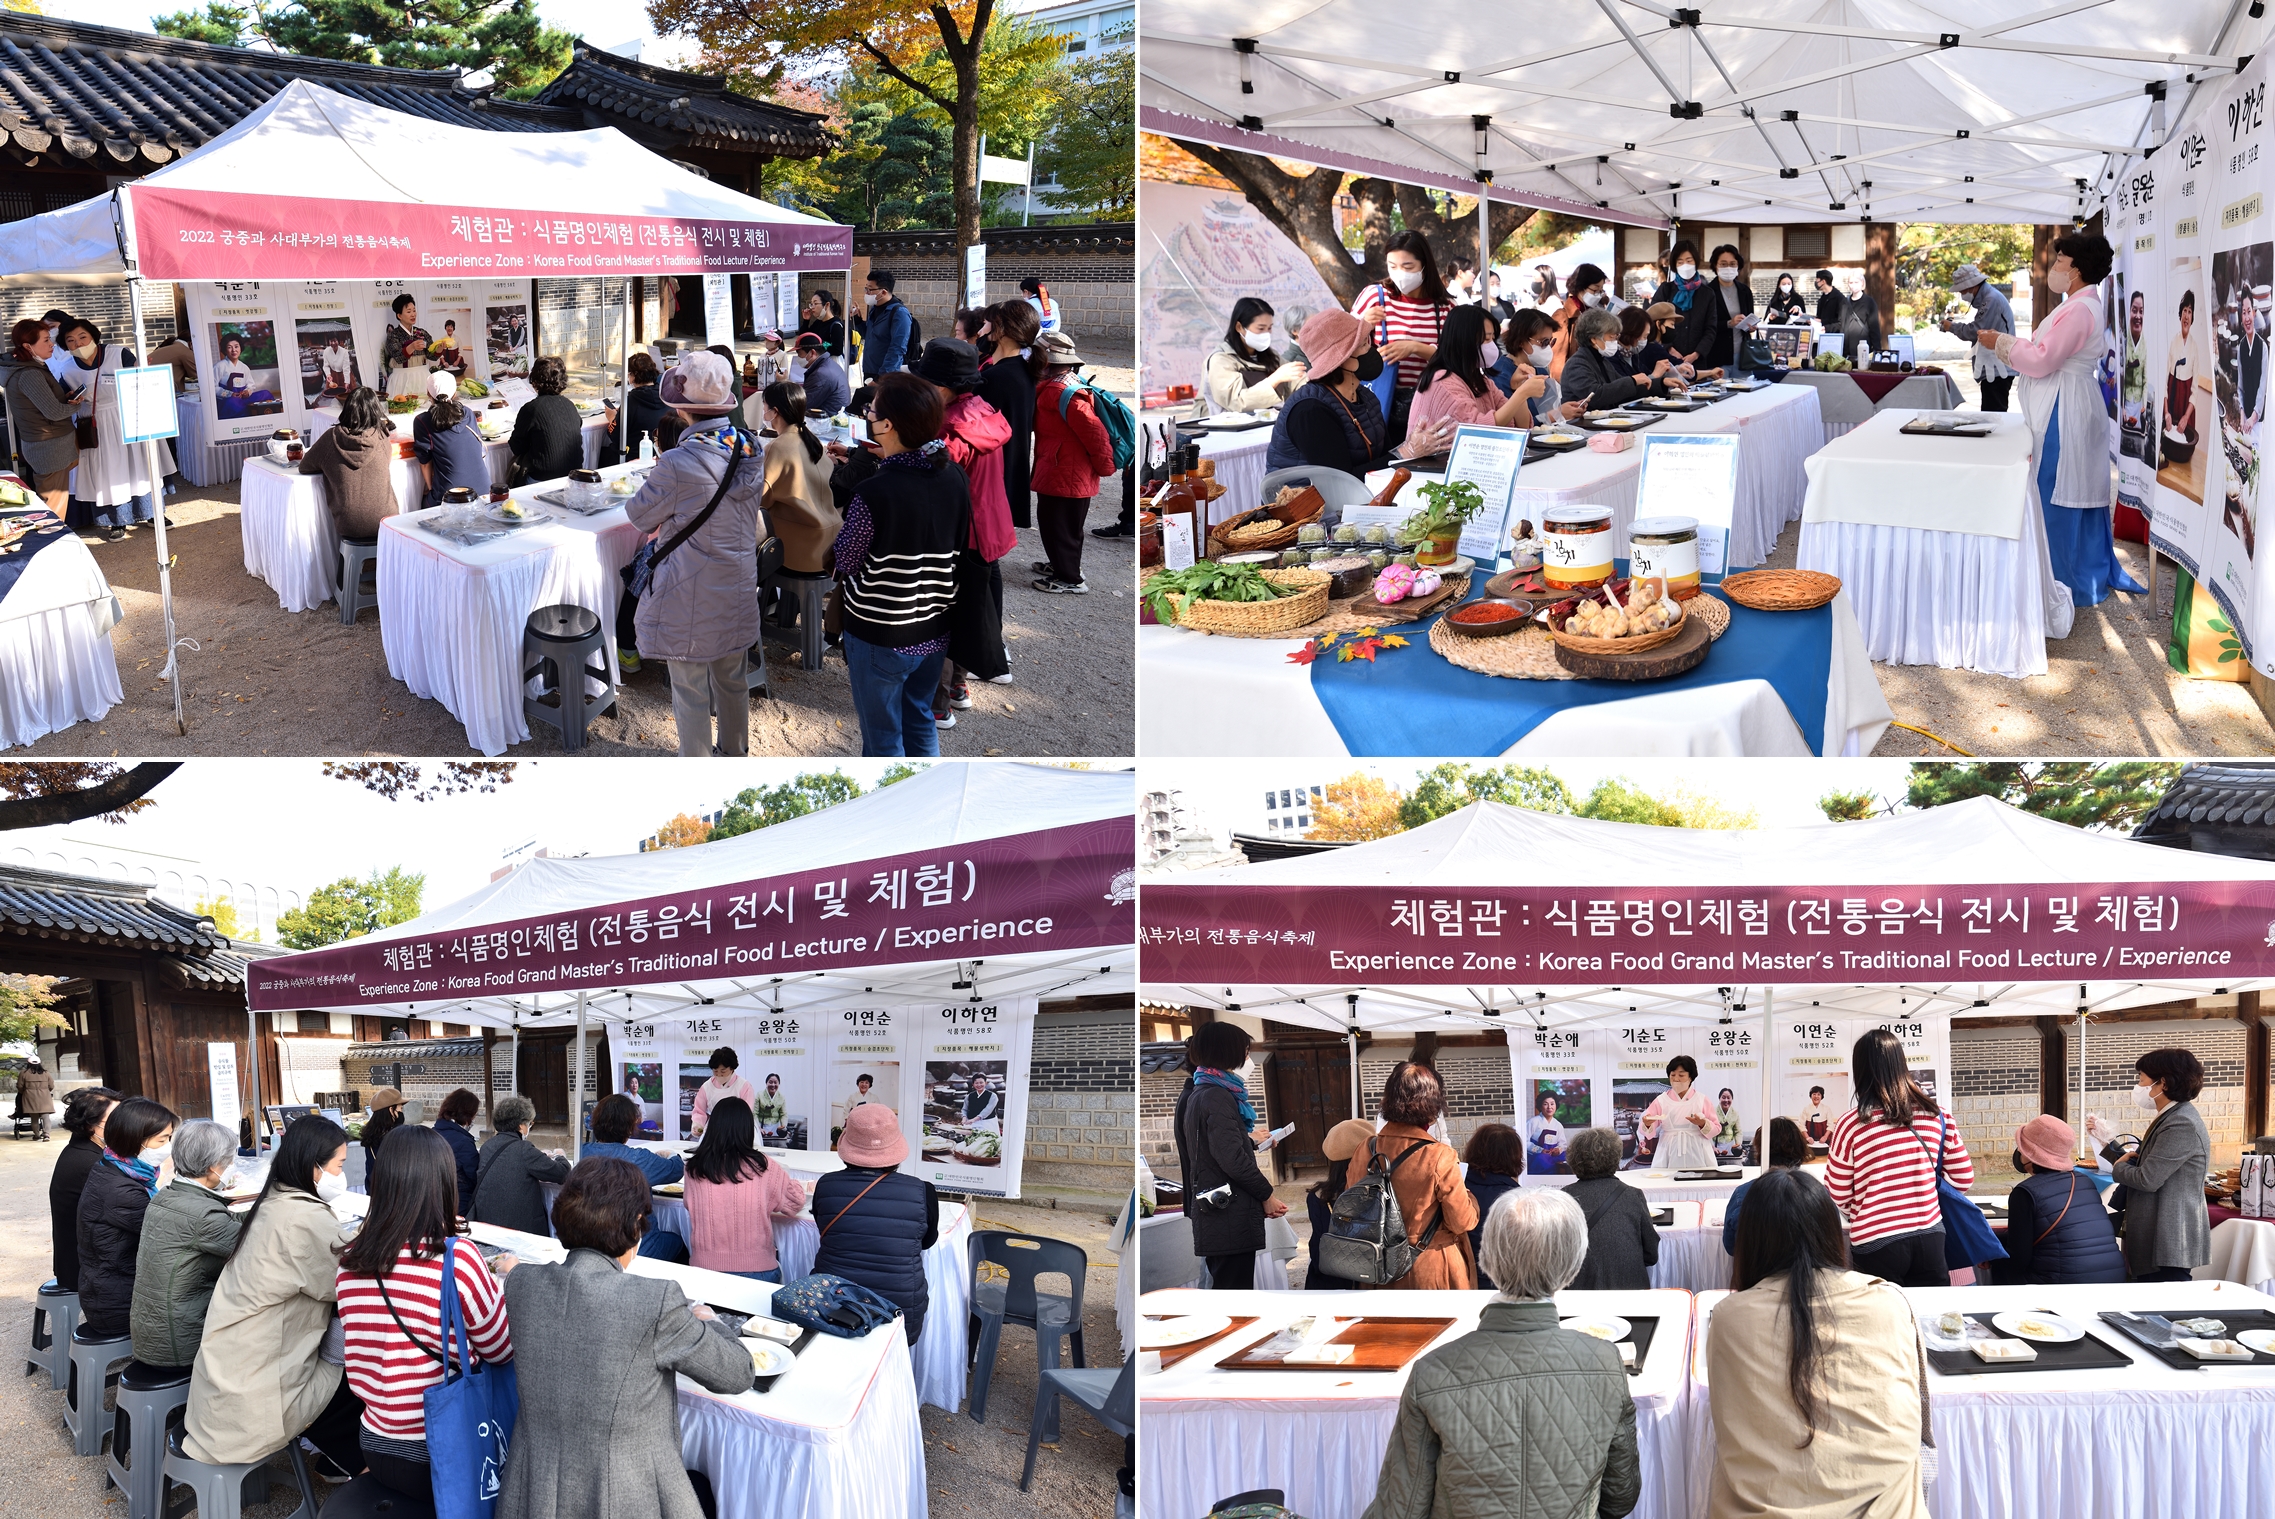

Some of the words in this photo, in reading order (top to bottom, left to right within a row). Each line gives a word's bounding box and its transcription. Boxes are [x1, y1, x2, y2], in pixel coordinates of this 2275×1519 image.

[179, 230, 214, 243] 2022
[219, 230, 265, 247] 궁중과
[270, 231, 337, 248] 사대부가의
[342, 234, 411, 250] 전통음식축제
[451, 215, 514, 243] 체험관
[533, 219, 633, 246] 식품명인체험
[639, 224, 697, 247] (전통음식
[701, 227, 725, 248] 전시
[729, 228, 740, 246] 및
[744, 228, 770, 248] 체험)
[421, 253, 492, 269] Experience
[496, 254, 523, 266] Zone
[534, 254, 565, 266] Korea
[568, 254, 592, 266] Food
[594, 254, 622, 266] Grand
[624, 254, 660, 266] Master's
[662, 255, 702, 266] Traditional
[703, 255, 722, 266] Food
[723, 255, 748, 266] Lecture
[754, 255, 786, 267] Experience
[1554, 540, 1575, 565] 김치
[1634, 550, 1651, 575] 김치
[383, 944, 433, 972] 체험관
[450, 919, 578, 965] 식품명인체험
[589, 899, 713, 948] (전통음식
[726, 885, 795, 932] 전시
[814, 876, 850, 922] 및
[867, 859, 977, 912] 체험)
[1390, 899, 1507, 937] 체험관
[1544, 898, 1769, 937] 식품명인체험
[1786, 897, 1943, 936] (전통음식
[1961, 896, 2029, 935] 전시
[2048, 896, 2080, 933] 및
[2094, 895, 2179, 933] 체험)
[1206, 928, 1315, 946] 전통음식축제
[359, 978, 410, 997] Experience
[413, 977, 438, 993] Zone
[448, 973, 480, 990] Korea
[484, 970, 514, 987] Food
[518, 965, 556, 984] Grand
[560, 959, 624, 980] Master's
[628, 949, 718, 975] Traditional
[724, 943, 774, 965] Food
[781, 934, 867, 960] Lecture
[894, 916, 1053, 950] Experience
[1330, 950, 1454, 973] Experience
[1462, 951, 1517, 970] Zone
[1539, 951, 1602, 970] Korea
[1610, 951, 1663, 970] Food
[1671, 951, 1734, 970] Grand
[1742, 950, 1833, 969] Master's
[1840, 950, 1951, 969] Traditional
[1958, 949, 2010, 968] Food
[2018, 948, 2097, 968] Lecture
[2119, 946, 2232, 968] Experience
[259, 981, 272, 990] 2022
[844, 1011, 891, 1026] 이연순
[941, 1006, 997, 1024] 이하연
[624, 1025, 654, 1038] 박순애
[687, 1020, 722, 1033] 기순도
[758, 1020, 800, 1035] 윤왕순
[1793, 1024, 1837, 1039] 이연순
[1535, 1033, 1579, 1048] 박순애
[1622, 1029, 1666, 1043] 기순도
[1709, 1030, 1752, 1046] 윤왕순
